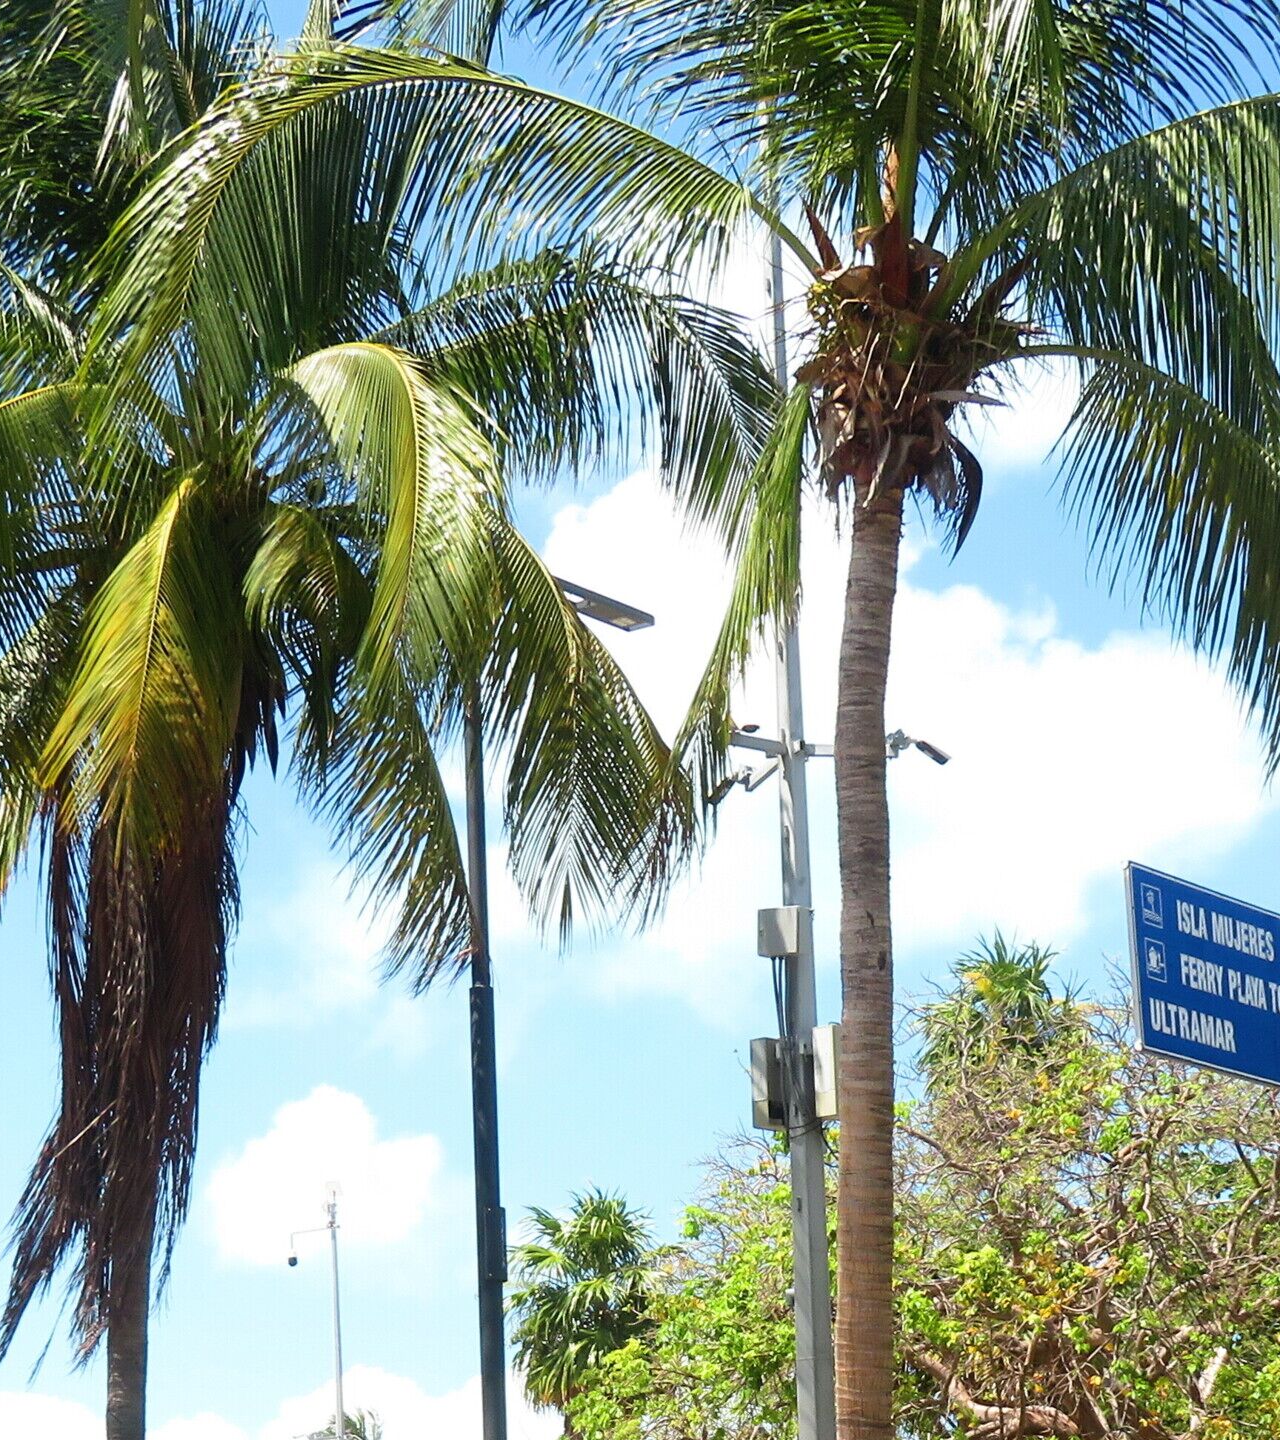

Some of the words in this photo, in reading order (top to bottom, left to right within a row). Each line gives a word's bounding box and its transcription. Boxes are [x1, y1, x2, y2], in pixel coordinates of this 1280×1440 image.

[1176, 899, 1208, 941] ISLA
[1212, 911, 1275, 962] MUJERES
[1180, 953, 1224, 997] FERRY
[1228, 968, 1268, 1011] PLAYA
[1149, 997, 1237, 1053] ULTRAMAR
